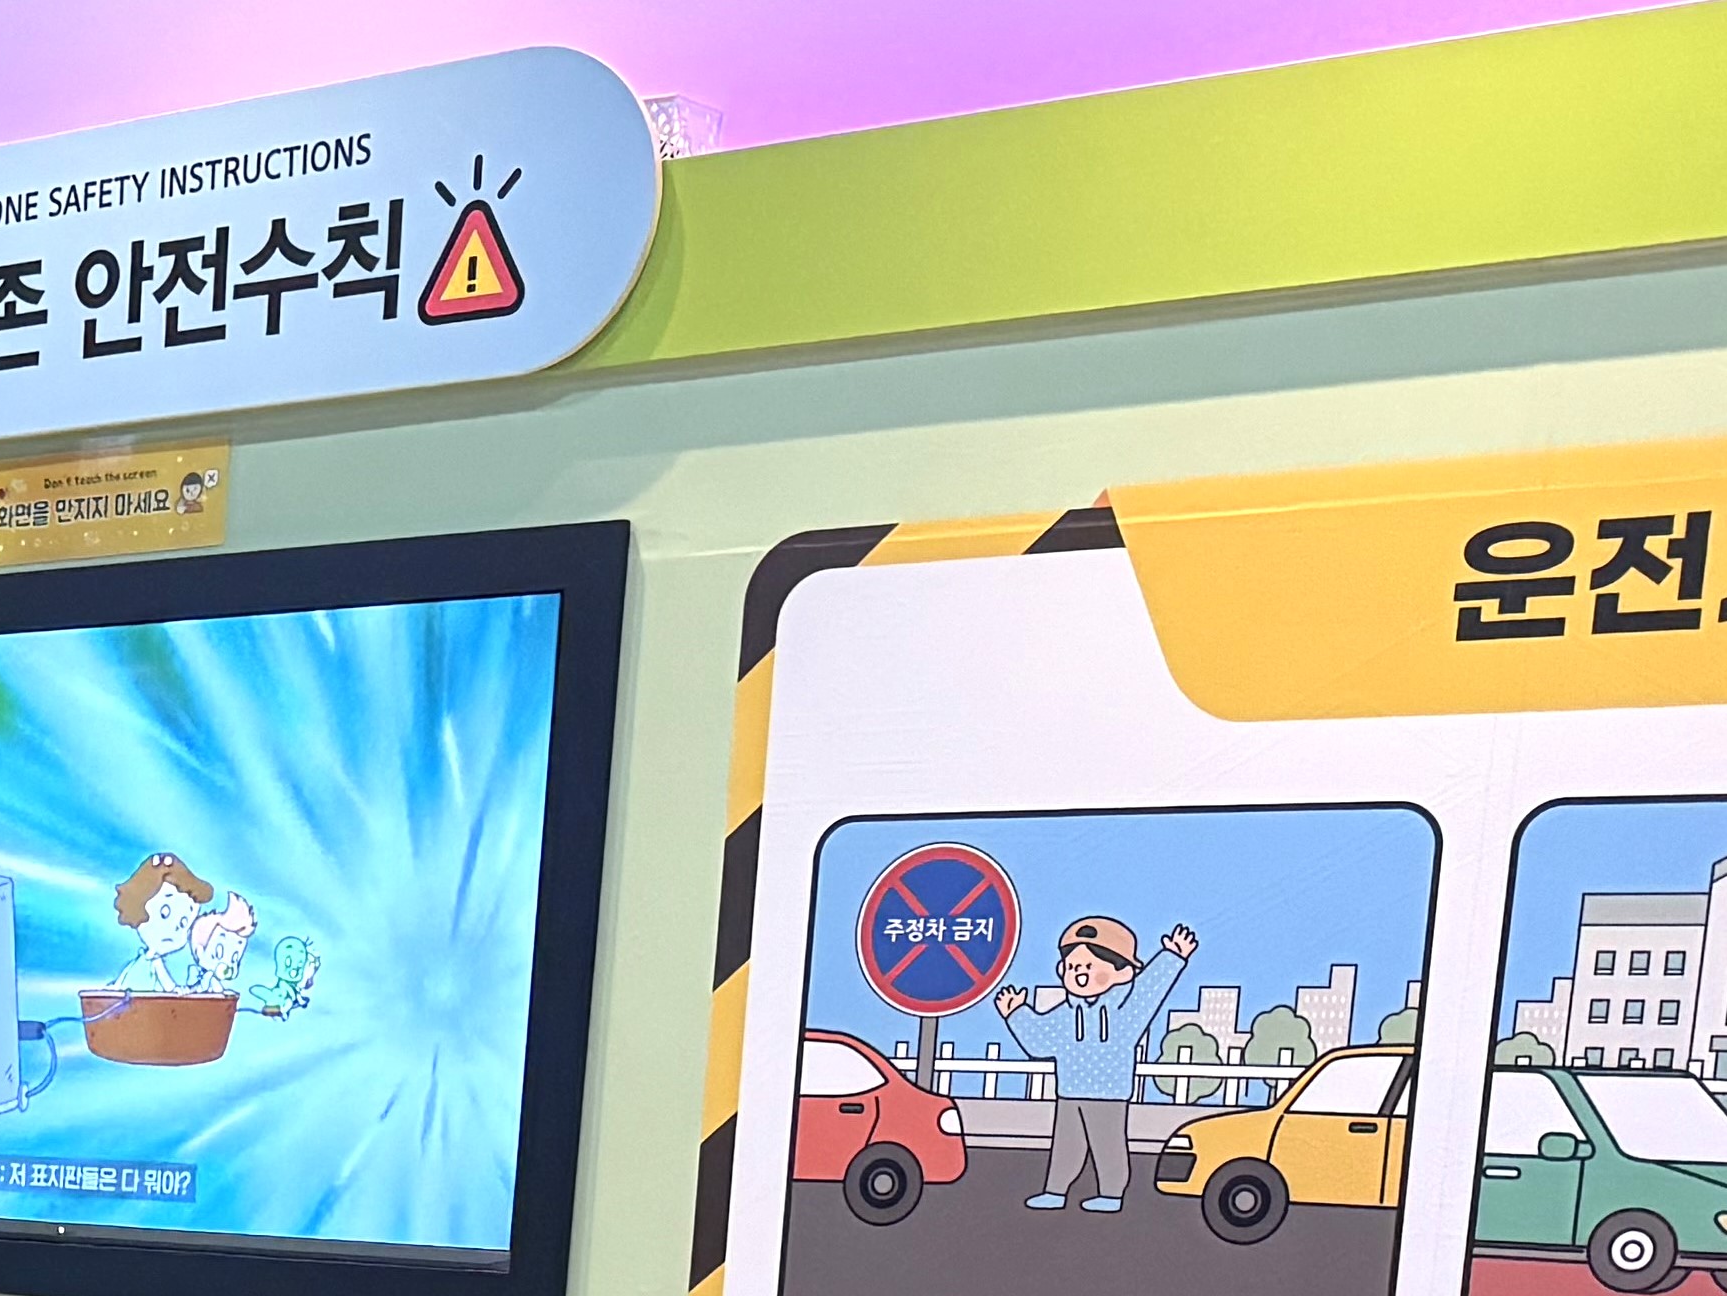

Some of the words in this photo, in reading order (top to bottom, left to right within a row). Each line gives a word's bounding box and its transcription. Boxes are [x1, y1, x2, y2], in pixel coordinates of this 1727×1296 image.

[48, 171, 150, 218] SAFETY
[159, 132, 373, 199] INSTRUCTIONS
[73, 197, 404, 358] 안전수칙
[55, 494, 109, 523] 만지지
[114, 489, 171, 516] 마세요
[1453, 510, 1727, 643] 운전
[883, 917, 947, 943] 주정차
[951, 917, 994, 943] 금지
[8, 1162, 27, 1187] 저
[29, 1164, 117, 1192] 표지판들은
[120, 1168, 140, 1193] 다
[143, 1169, 192, 1196] 뭐야?
